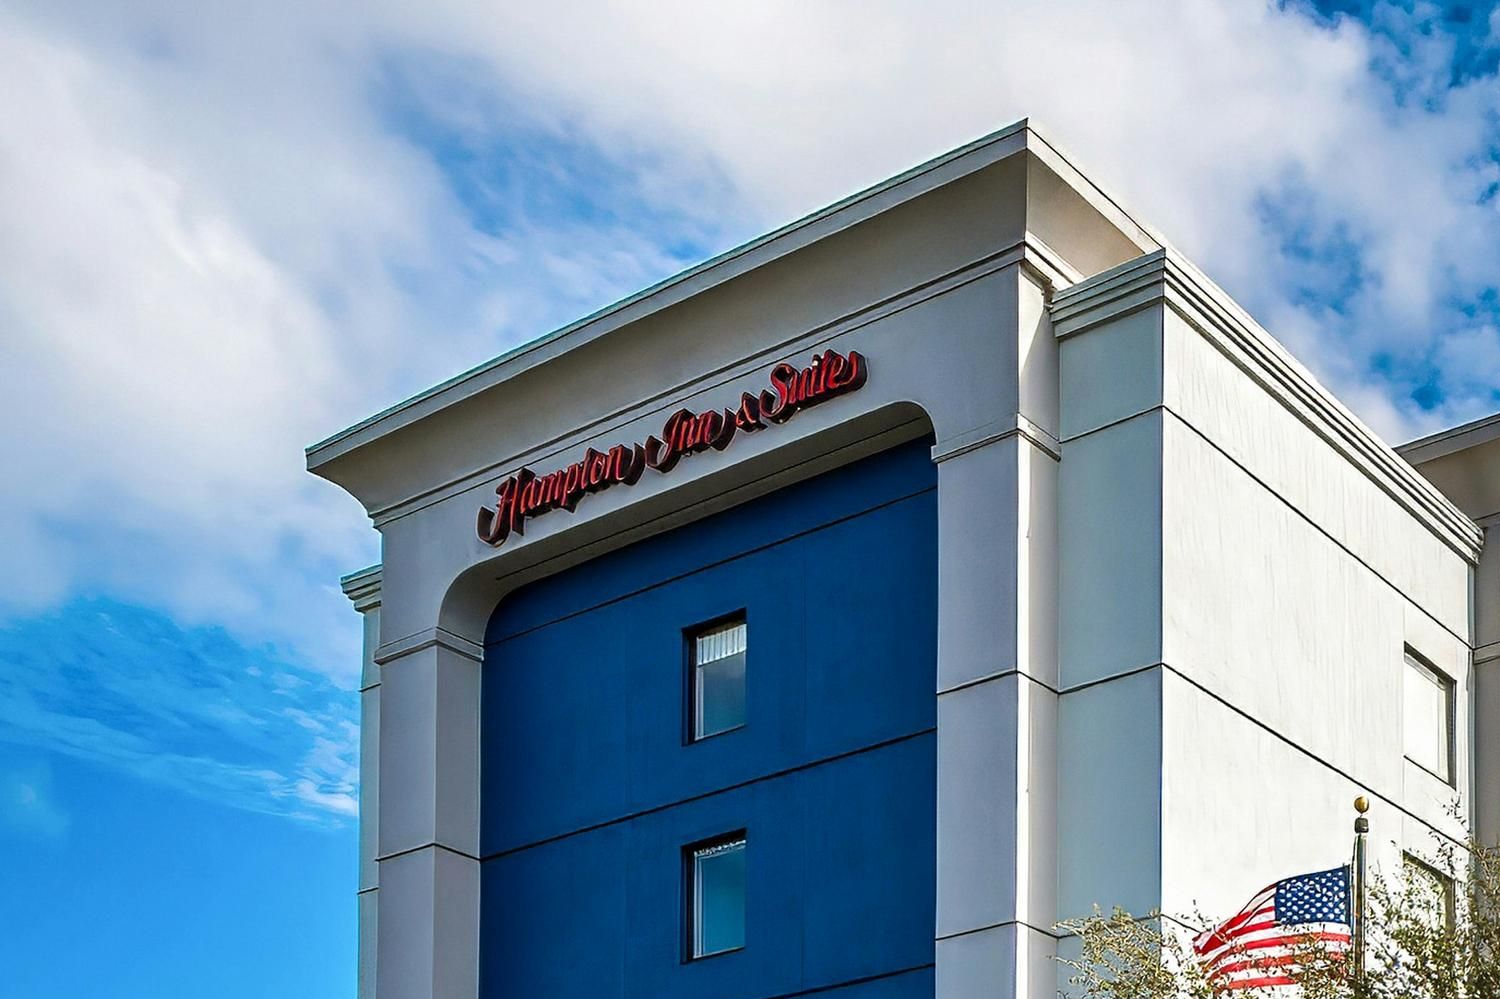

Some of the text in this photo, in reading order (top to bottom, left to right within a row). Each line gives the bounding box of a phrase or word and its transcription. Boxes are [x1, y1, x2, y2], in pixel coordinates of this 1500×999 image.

[477, 349, 868, 548] Hampton Inn & Suites
